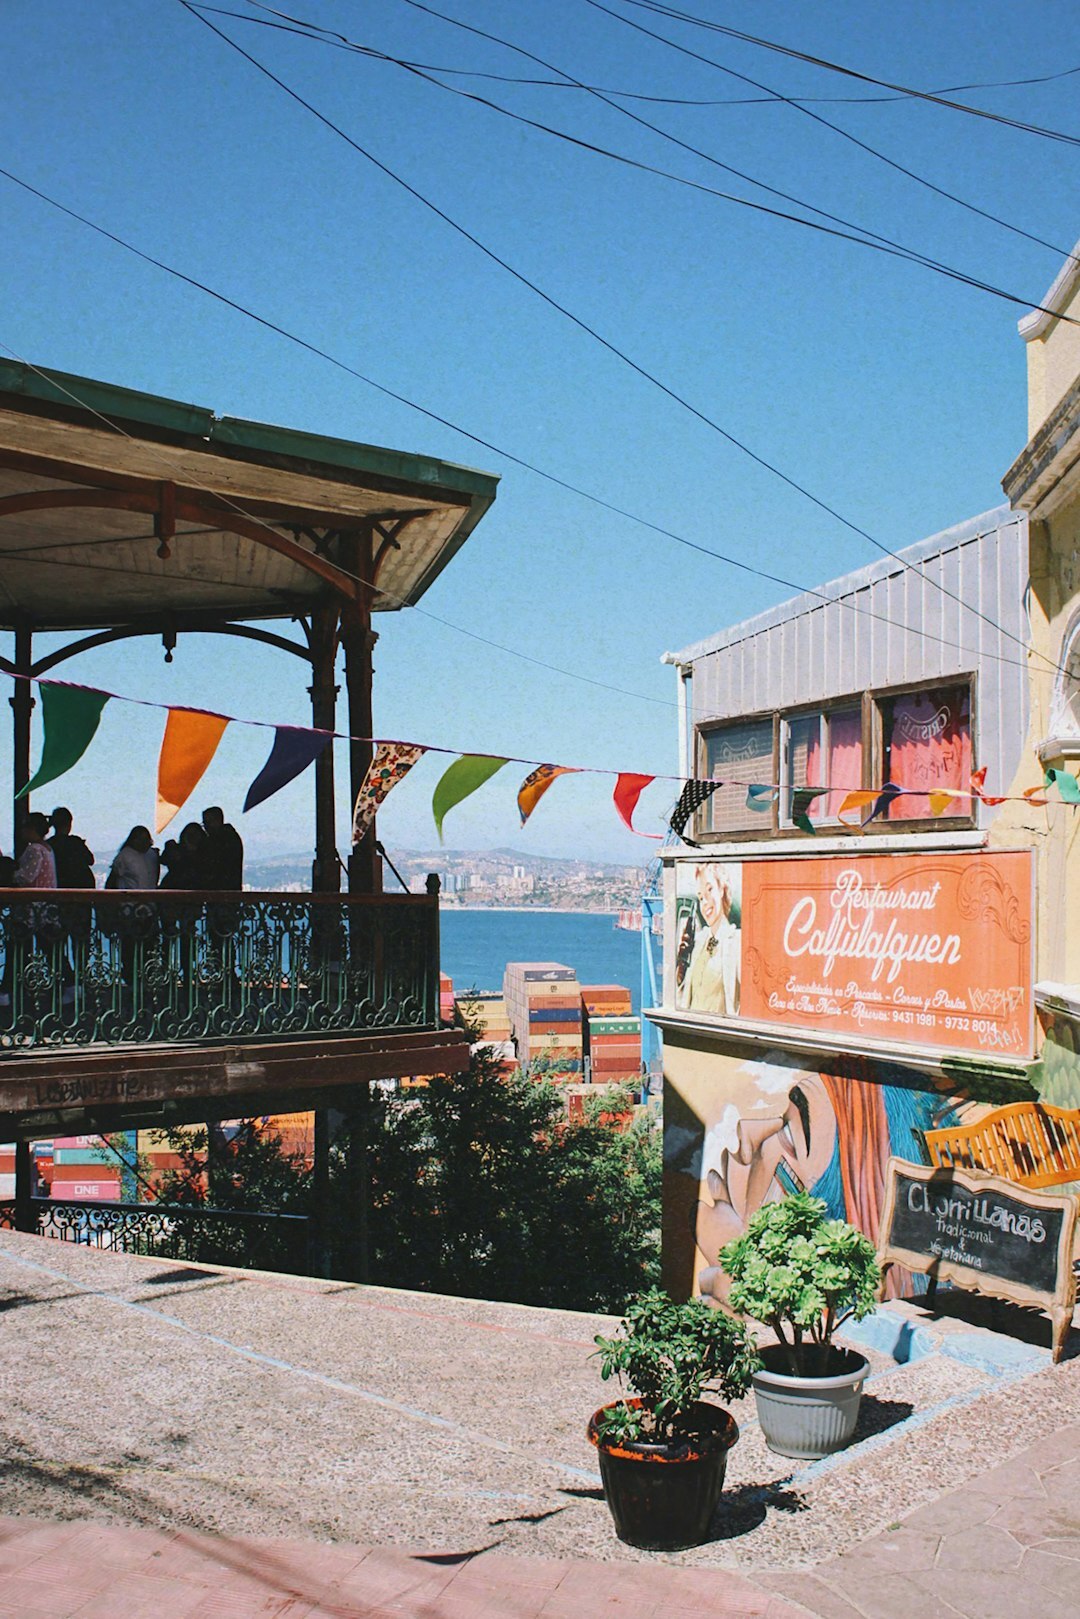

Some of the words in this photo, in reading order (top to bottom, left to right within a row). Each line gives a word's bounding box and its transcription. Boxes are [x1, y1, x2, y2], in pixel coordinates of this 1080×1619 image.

[830, 869, 942, 930] Restaurant
[783, 896, 961, 984] Calfulafquen
[923, 998, 931, 1012] y
[931, 989, 967, 1010] Pastas
[892, 1011, 914, 1025] 9431
[916, 1013, 936, 1026] 1981
[945, 1016, 969, 1030] 9732
[971, 1019, 998, 1034] 8014
[74, 1185, 99, 1195] ONE
[958, 1238, 966, 1251] &
